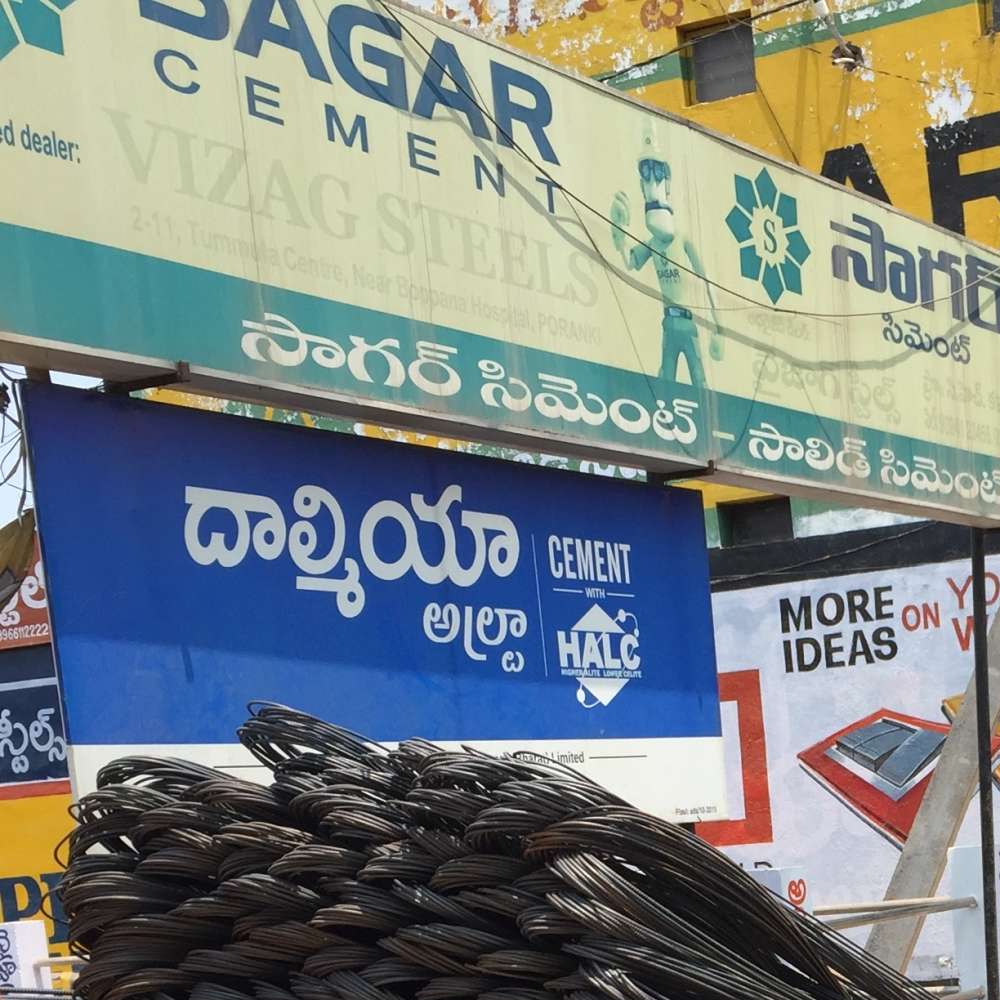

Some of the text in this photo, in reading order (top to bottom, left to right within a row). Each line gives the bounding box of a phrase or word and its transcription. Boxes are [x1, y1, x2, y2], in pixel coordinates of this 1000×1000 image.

[21, 124, 80, 164] dealer:
[154, 49, 562, 213] CEMENT
[101, 106, 600, 307] VIZAG STEELS
[352, 263, 392, 294] Near
[882, 313, 970, 364] సిమెంట్
[241, 312, 462, 396] సాగర్
[478, 359, 699, 444] సిమెంట్
[749, 422, 871, 478] సాలిడ్
[184, 484, 520, 618] దాల్మియా
[548, 535, 631, 585] CEMENT
[584, 587, 606, 598] WITH
[779, 585, 894, 634] MORE
[901, 602, 941, 632] ON
[423, 602, 528, 673] అల్ట్రా
[557, 630, 641, 670] HALC
[783, 626, 898, 673] IDEAS
